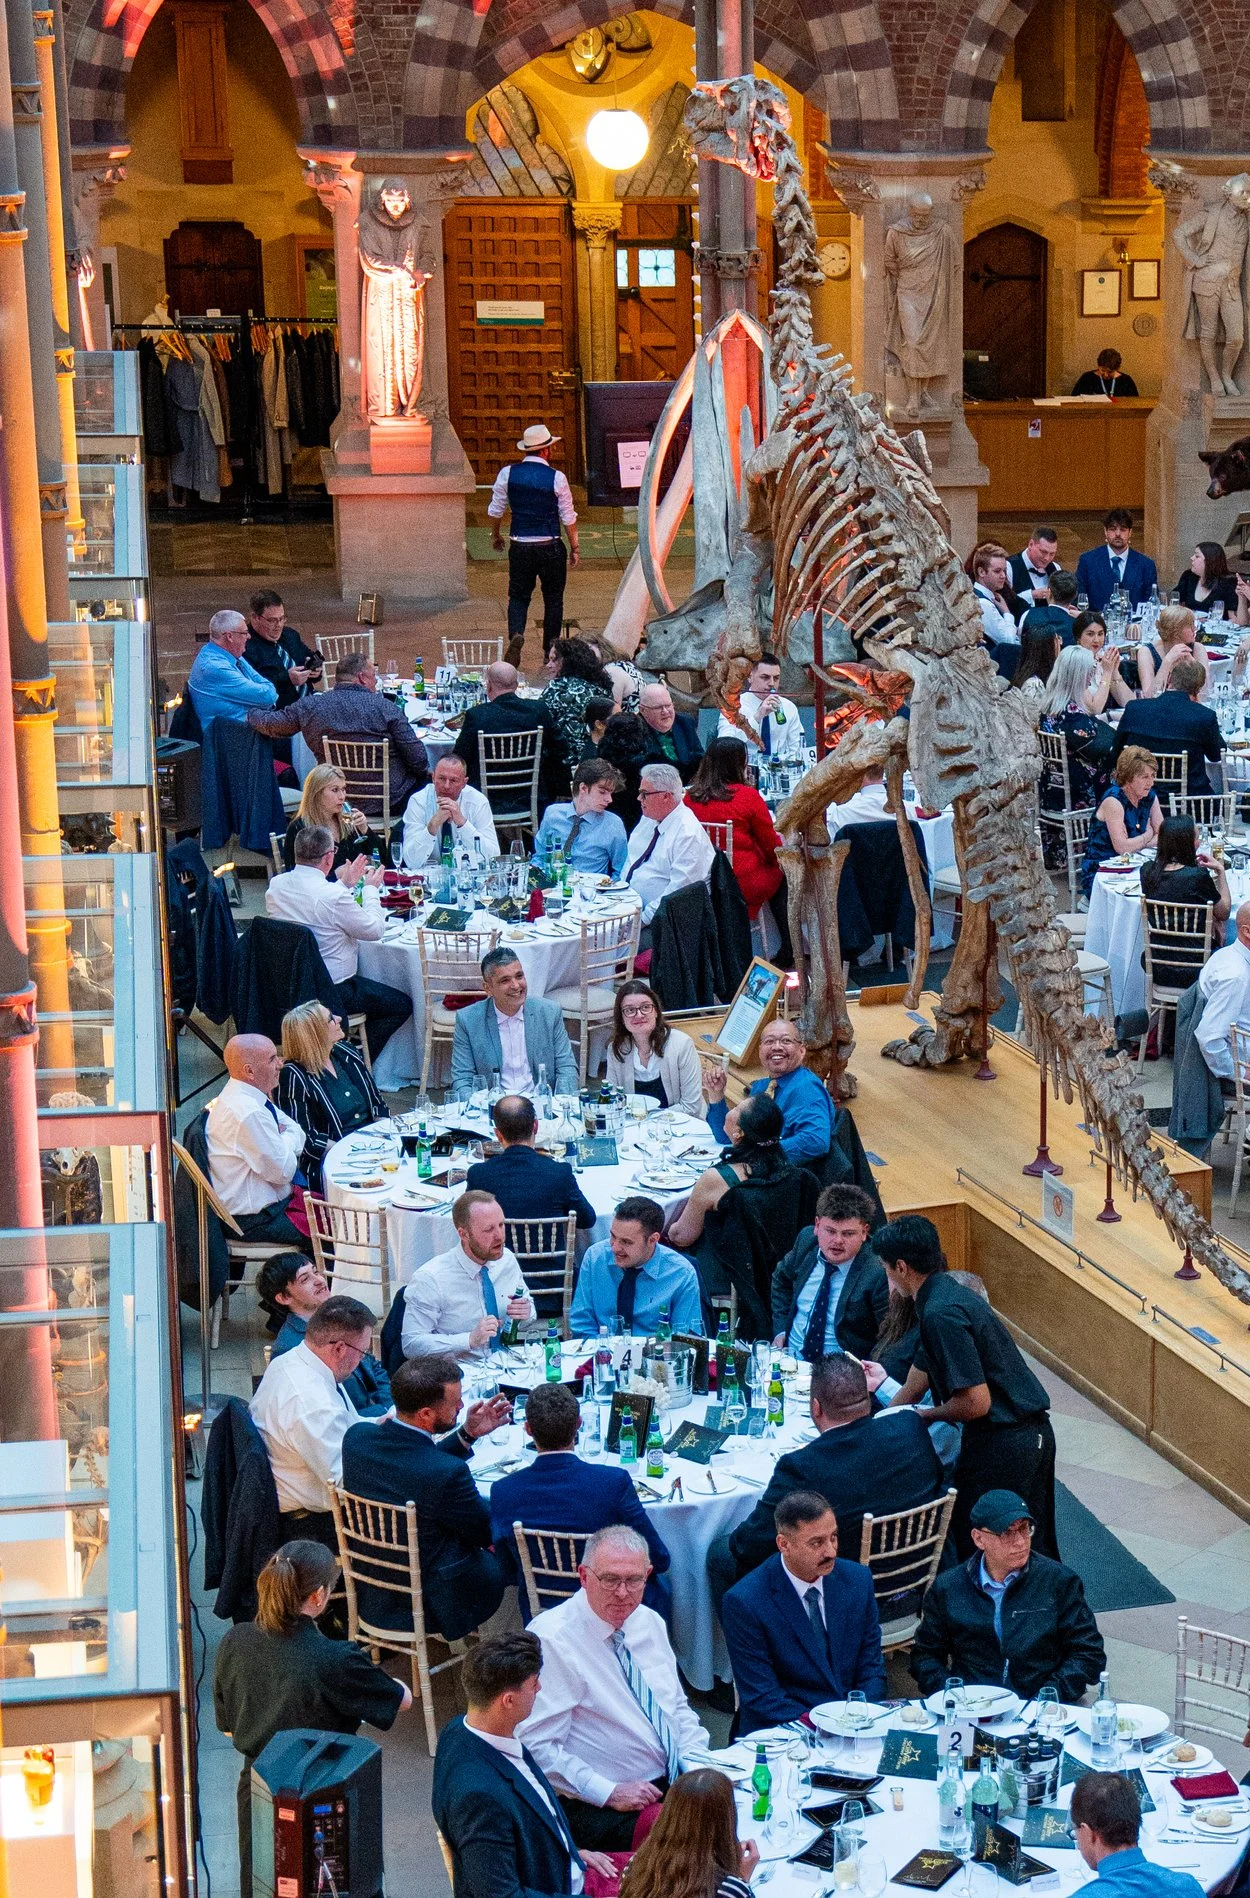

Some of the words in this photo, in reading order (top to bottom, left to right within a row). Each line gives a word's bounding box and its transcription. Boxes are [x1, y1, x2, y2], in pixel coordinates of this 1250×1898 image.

[440, 670, 450, 681] 11
[622, 1349, 632, 1365] 4
[950, 1731, 962, 1750] 2
